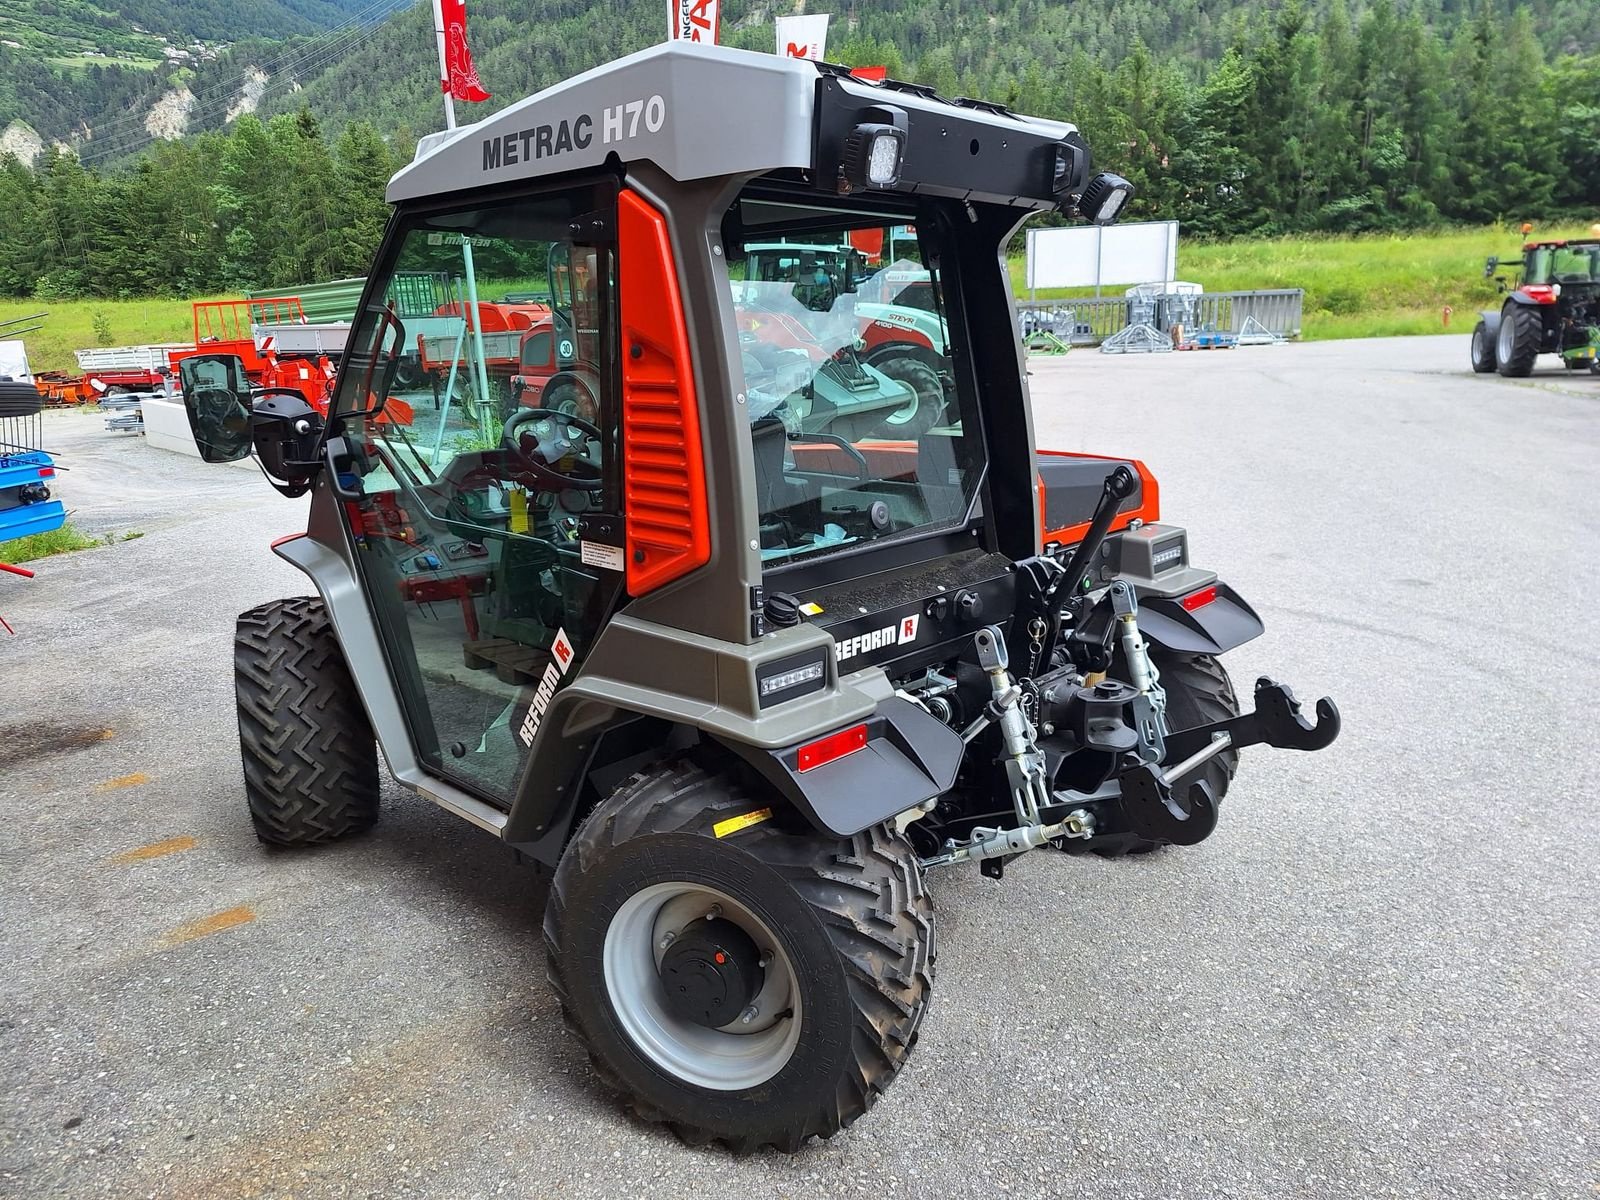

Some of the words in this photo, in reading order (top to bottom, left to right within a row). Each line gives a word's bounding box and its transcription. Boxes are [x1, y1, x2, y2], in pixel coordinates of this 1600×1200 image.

[483, 114, 592, 171] METRAC
[603, 95, 665, 144] H70
[875, 320, 893, 329] 4100
[889, 314, 914, 324] STEYR
[563, 343, 571, 354] 30
[835, 625, 896, 662] REFORM
[904, 619, 913, 638] R
[519, 662, 561, 748] REFORM
[555, 639, 570, 664] R
